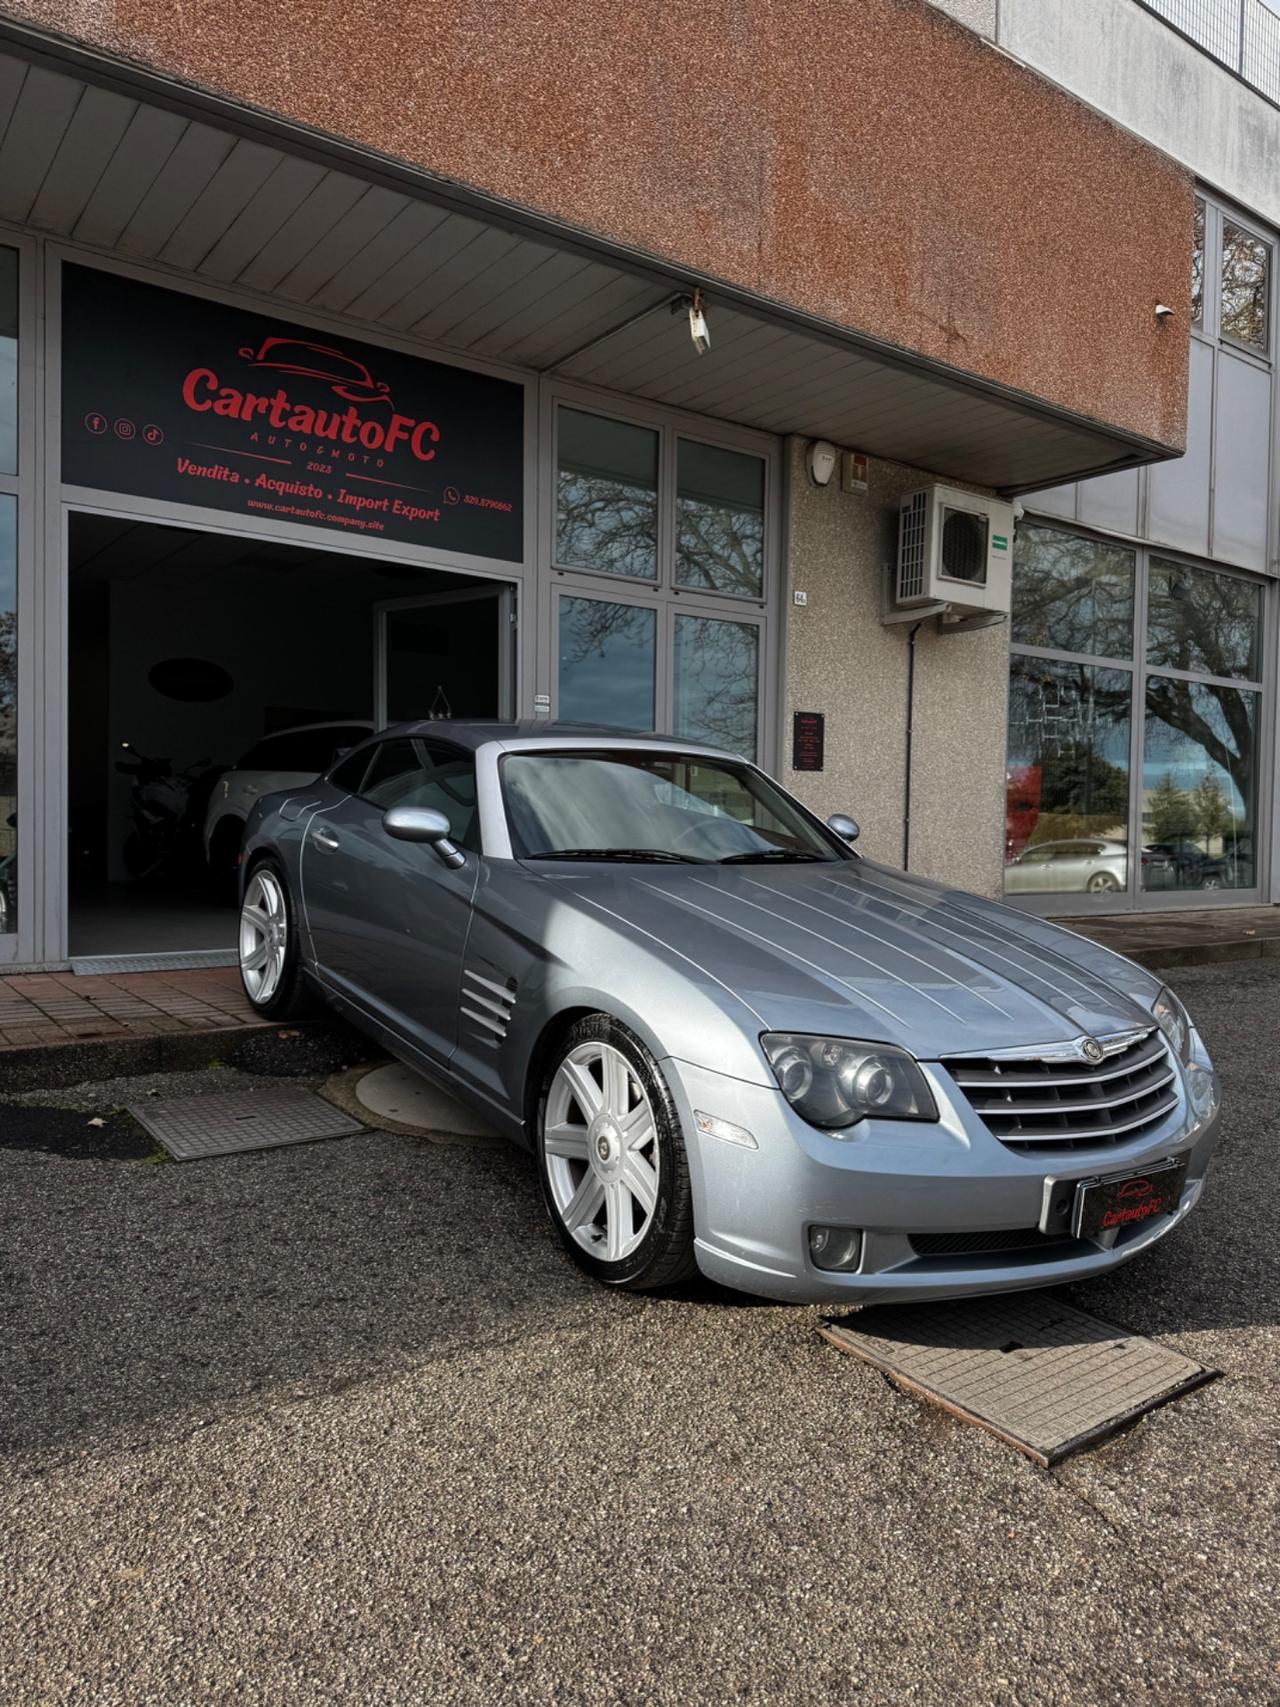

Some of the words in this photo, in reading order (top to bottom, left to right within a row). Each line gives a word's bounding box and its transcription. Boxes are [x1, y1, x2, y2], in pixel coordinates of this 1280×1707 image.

[182, 367, 441, 462] CartautoFC
[176, 457, 240, 484] Vendita
[255, 473, 324, 499] Acquisto
[337, 488, 390, 512] Import
[391, 498, 441, 521] Export
[247, 500, 385, 531] www.cartautofc.company.site
